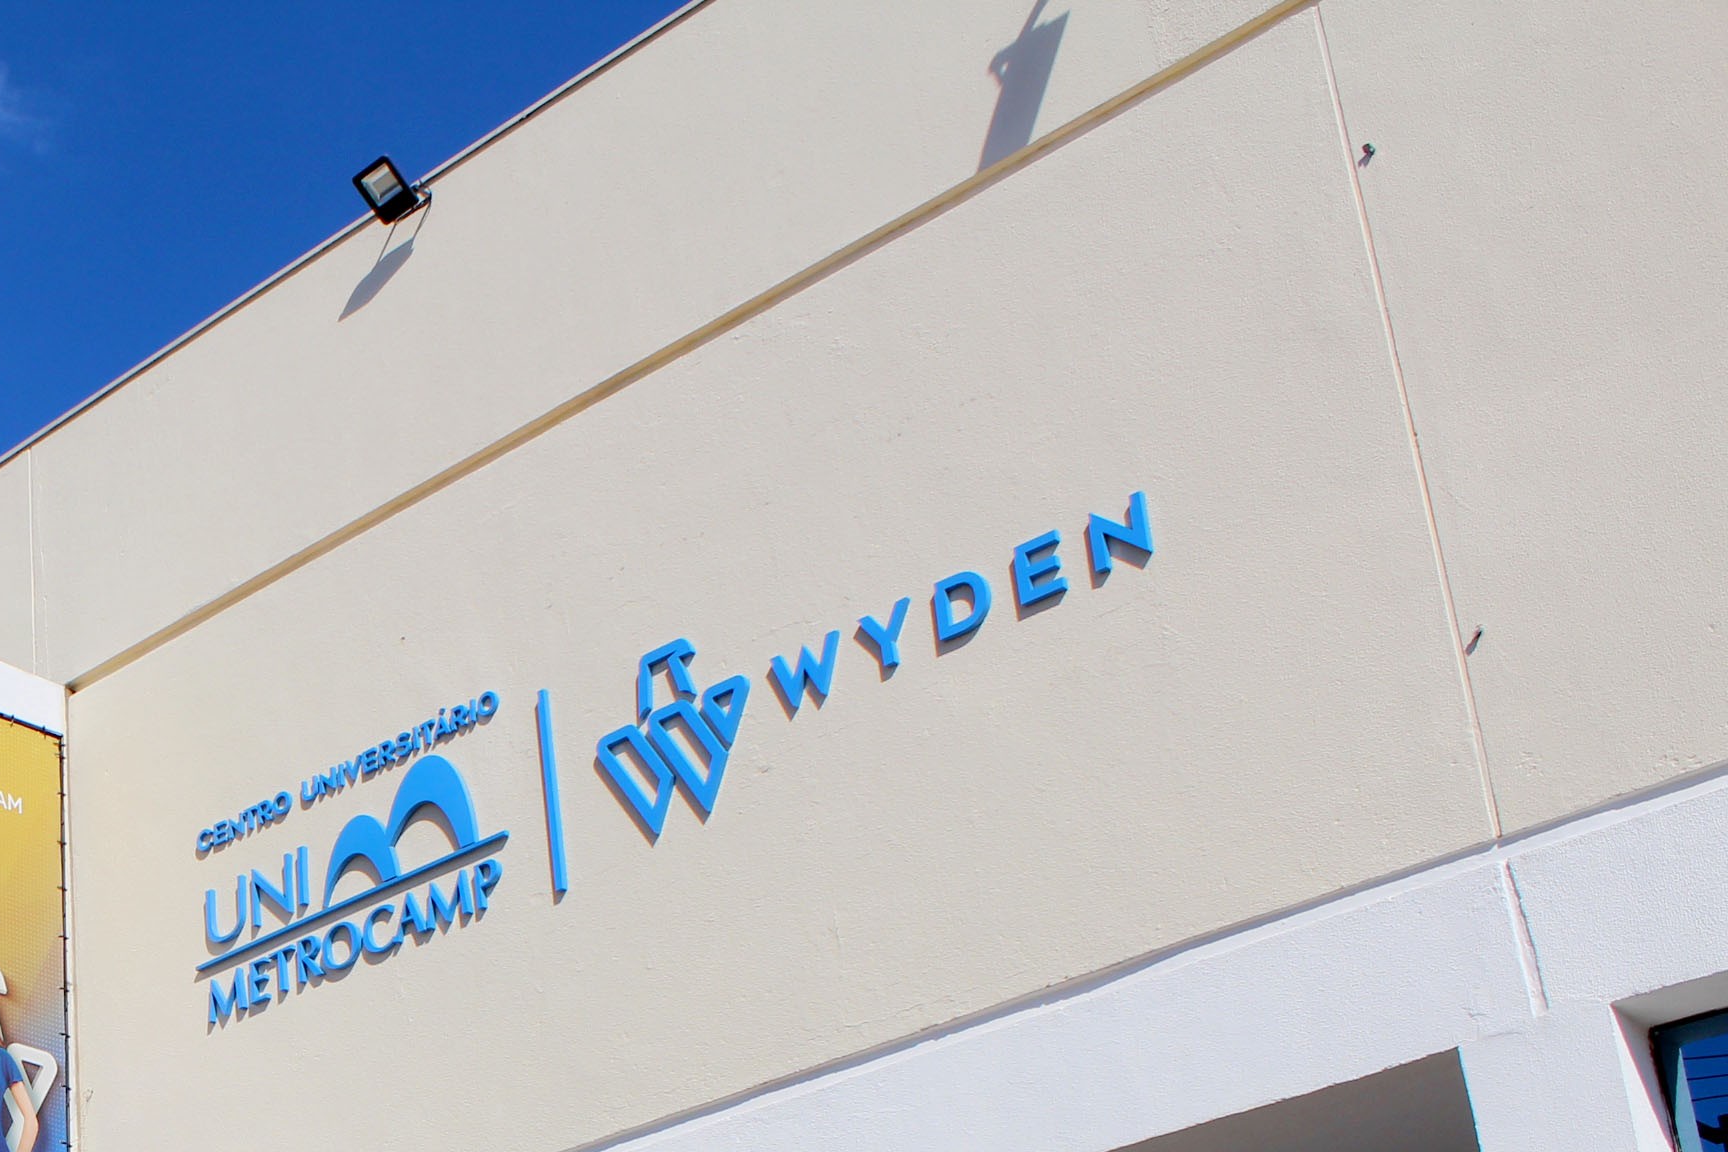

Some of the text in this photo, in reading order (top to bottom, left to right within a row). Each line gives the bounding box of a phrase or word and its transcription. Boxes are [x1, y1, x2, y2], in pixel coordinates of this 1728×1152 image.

[769, 491, 1153, 709] WYDEN
[196, 690, 499, 853] CENTRO UNIVERSITÁRIO
[204, 846, 308, 945] UNI
[208, 858, 503, 1024] METROCAMP
